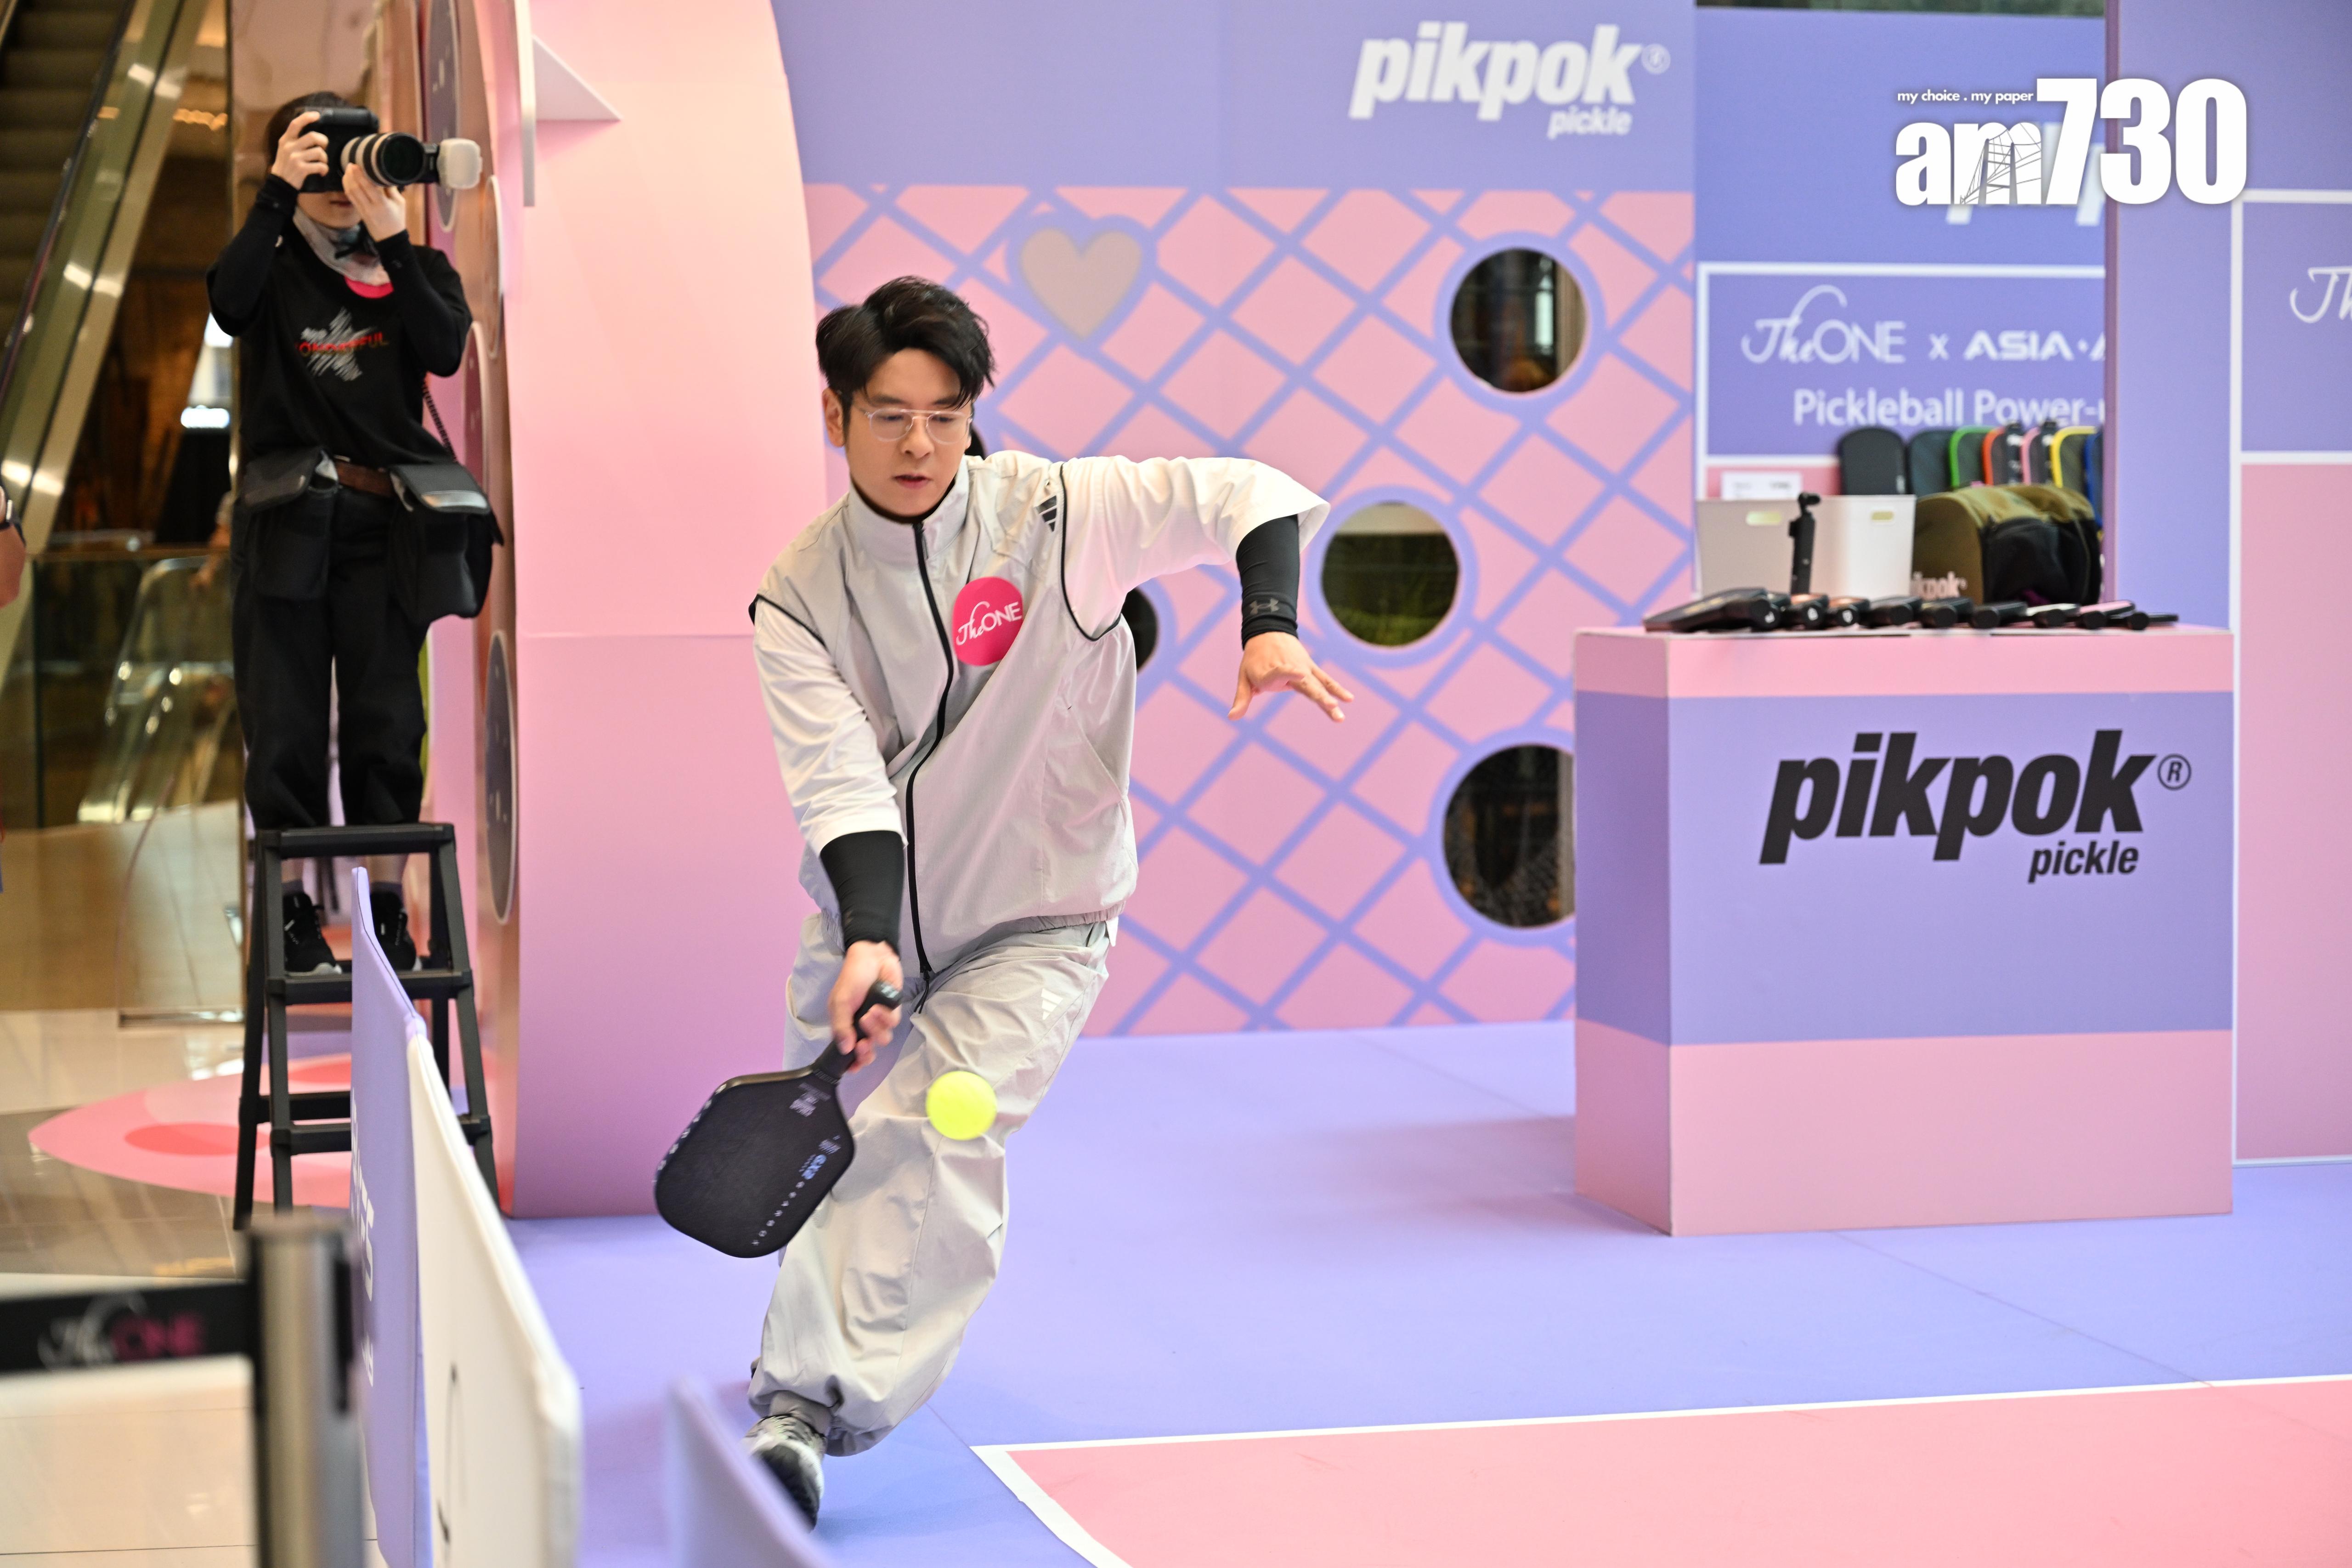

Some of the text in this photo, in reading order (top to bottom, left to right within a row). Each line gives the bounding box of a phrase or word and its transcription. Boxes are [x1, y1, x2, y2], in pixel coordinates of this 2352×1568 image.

[1547, 105, 1632, 140] pickle
[1794, 388, 2105, 426] Pickleball Power-
[2028, 841, 2139, 884] pickle
